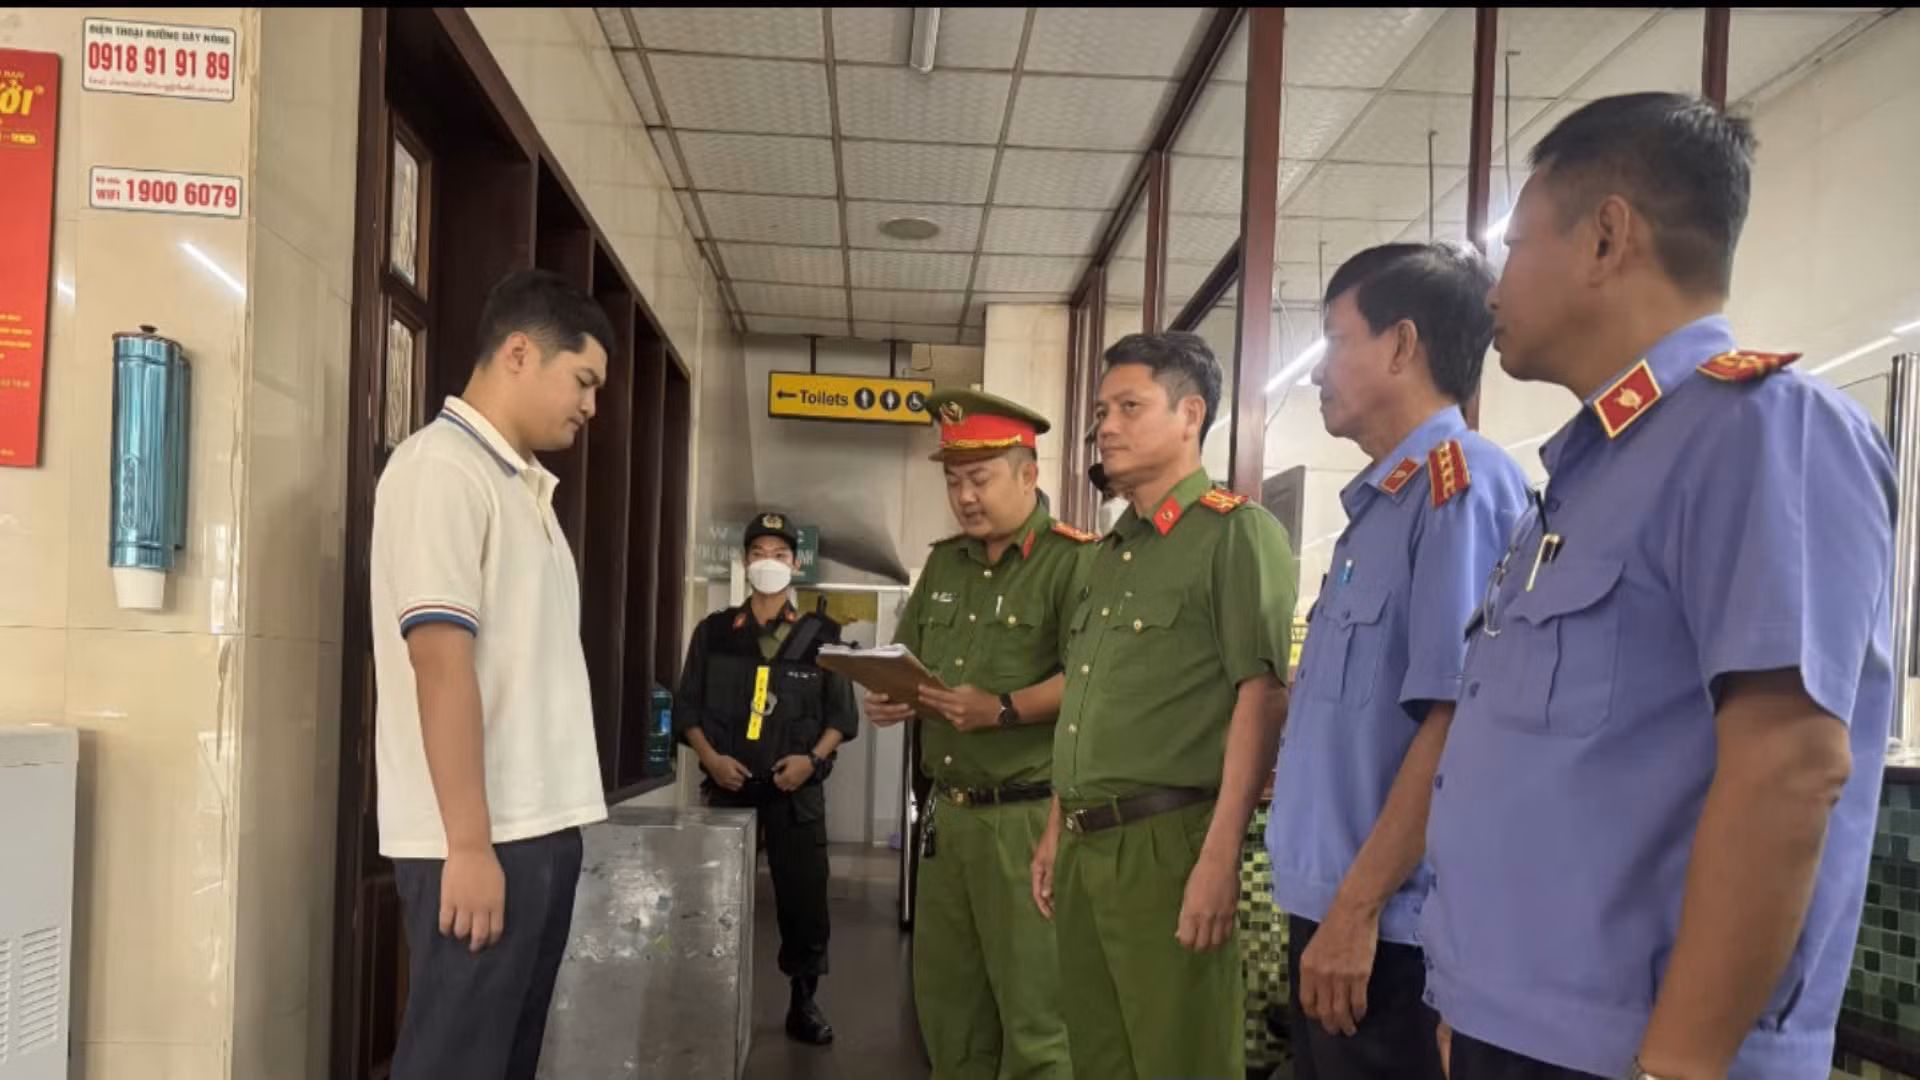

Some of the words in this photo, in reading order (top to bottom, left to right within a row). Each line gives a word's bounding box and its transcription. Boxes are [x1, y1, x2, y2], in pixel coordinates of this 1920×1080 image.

[88, 41, 138, 73] 0918
[144, 46, 166, 76] 91
[175, 48, 197, 78] 91
[205, 51, 230, 80] 89
[126, 178, 178, 204] 1900
[184, 182, 237, 209] 6079
[799, 388, 849, 407] Toilets
